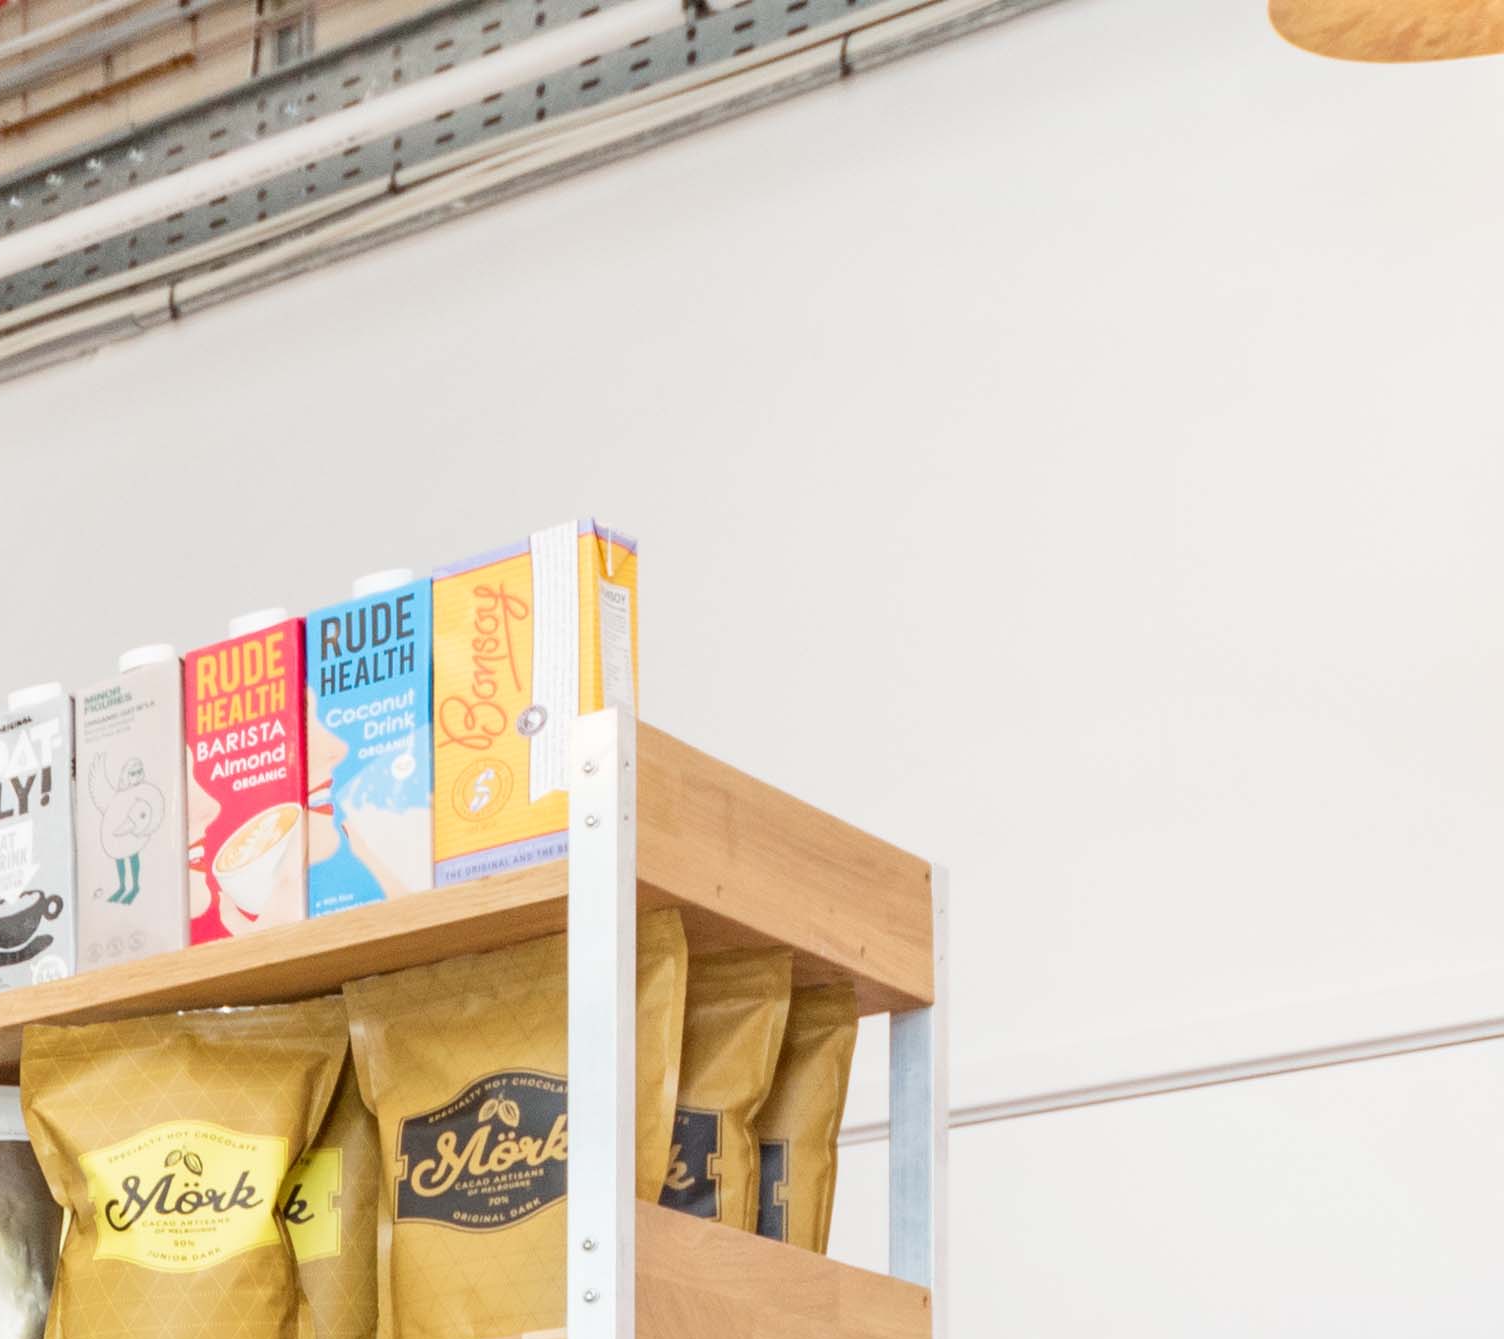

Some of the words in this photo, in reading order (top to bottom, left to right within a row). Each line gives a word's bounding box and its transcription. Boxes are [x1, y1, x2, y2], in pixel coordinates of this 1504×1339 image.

[320, 592, 416, 662] RUDE
[196, 631, 286, 702] RUDE
[320, 641, 416, 697] HEALTH
[438, 580, 530, 751] Bonsoy
[196, 679, 286, 736] HEALTH
[325, 687, 416, 729] Coconut
[364, 711, 416, 742] Drink
[196, 719, 286, 763] BARISTA
[210, 742, 287, 782] Almond
[232, 767, 288, 792] ORGANIC
[444, 868, 463, 881] THE
[464, 857, 510, 880] ORIGINAL
[513, 852, 534, 865] AND
[537, 845, 558, 858] THE
[427, 1087, 482, 1124] SPECIALTY
[484, 1078, 508, 1091] HOT
[167, 1131, 189, 1140] HOT
[194, 1131, 258, 1152] CHOCOLATE
[410, 1114, 568, 1198] Mörk
[104, 1170, 264, 1232] Mörk
[454, 1178, 490, 1191] CACAO
[493, 1167, 545, 1184] ARTISANS
[452, 1211, 507, 1225] ORIGINAL
[509, 1197, 542, 1218] DARK
